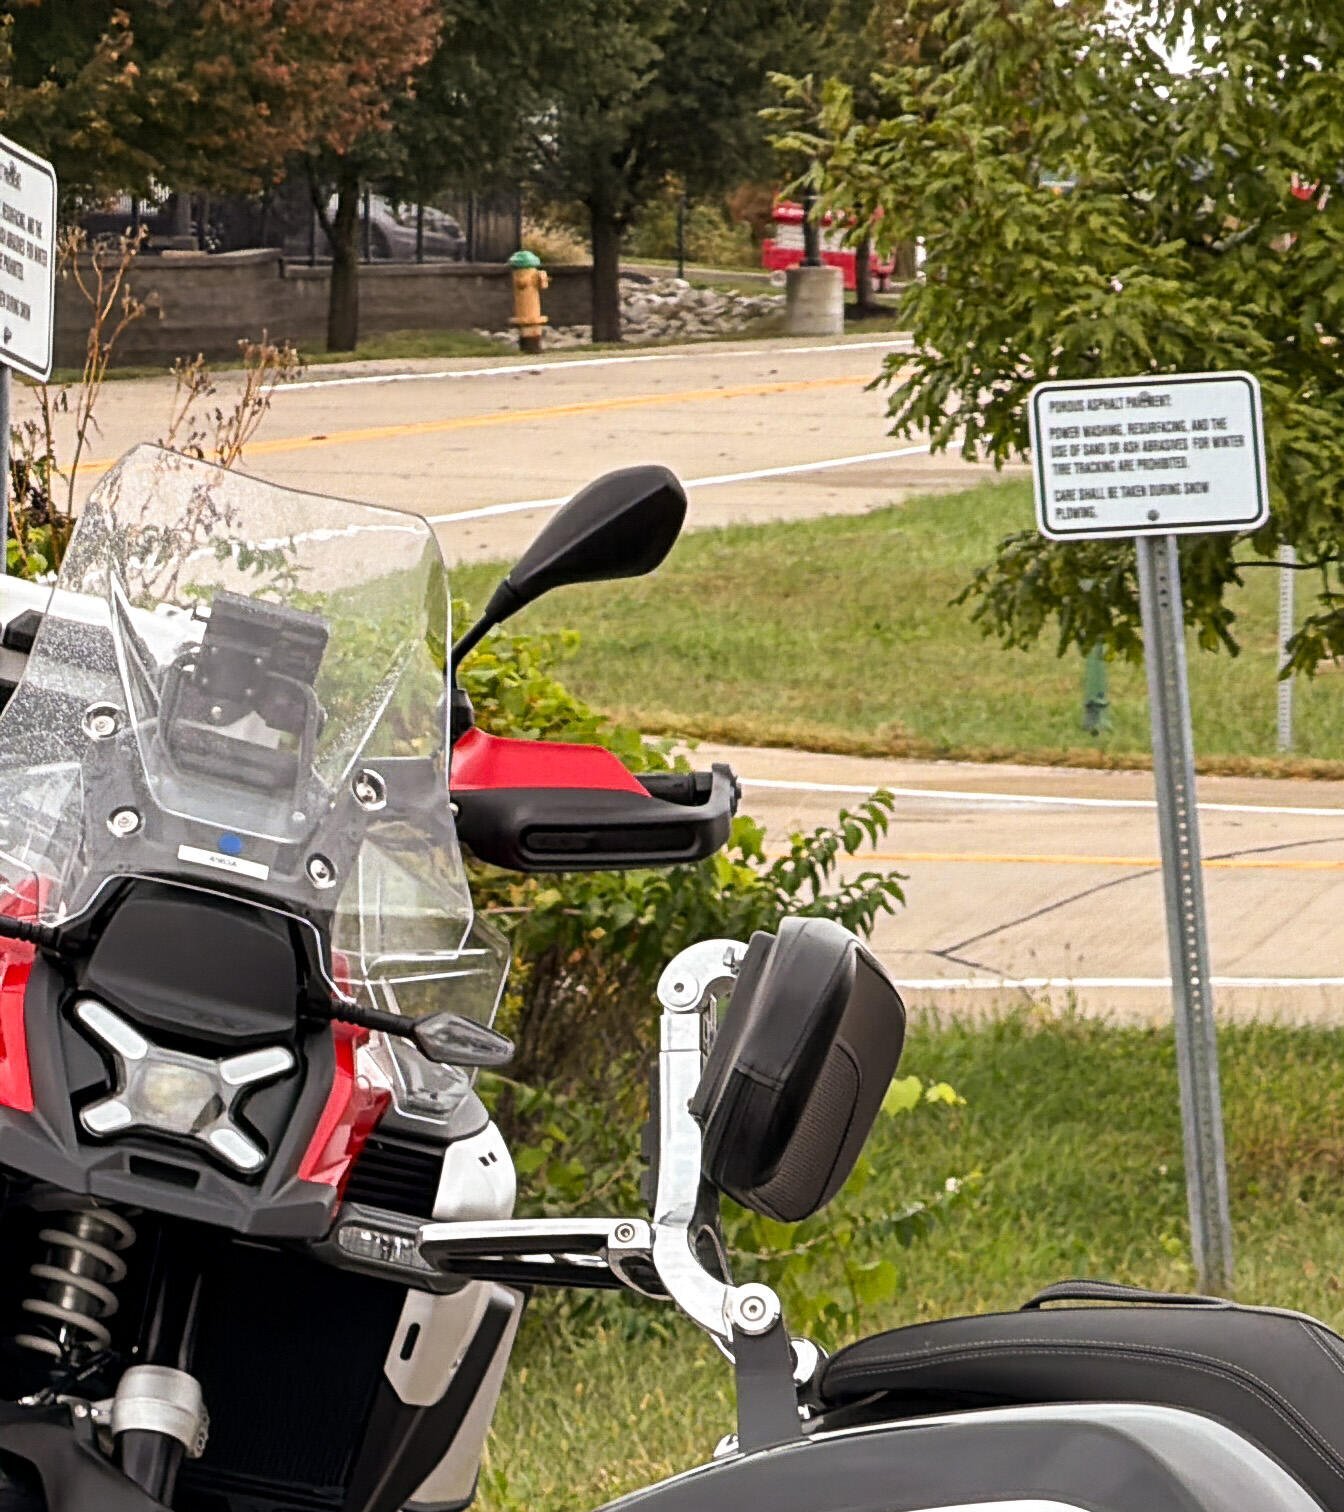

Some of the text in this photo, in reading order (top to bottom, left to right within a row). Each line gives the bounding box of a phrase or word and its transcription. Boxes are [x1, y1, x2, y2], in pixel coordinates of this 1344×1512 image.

[1049, 426, 1080, 439] POWER
[1192, 418, 1209, 431] AND
[1210, 416, 1227, 430] THE
[1051, 444, 1067, 458] USE
[1070, 443, 1080, 457] OF
[1083, 442, 1105, 456] SAND
[1192, 436, 1210, 449] FOR
[1212, 434, 1245, 448] WINTER
[1052, 462, 1072, 475] TIME
[1073, 460, 1116, 474] TRACKING
[1119, 459, 1135, 472] ARE
[1054, 481, 1210, 502] CARE SHALL BE TAKEN DURING SNOW
